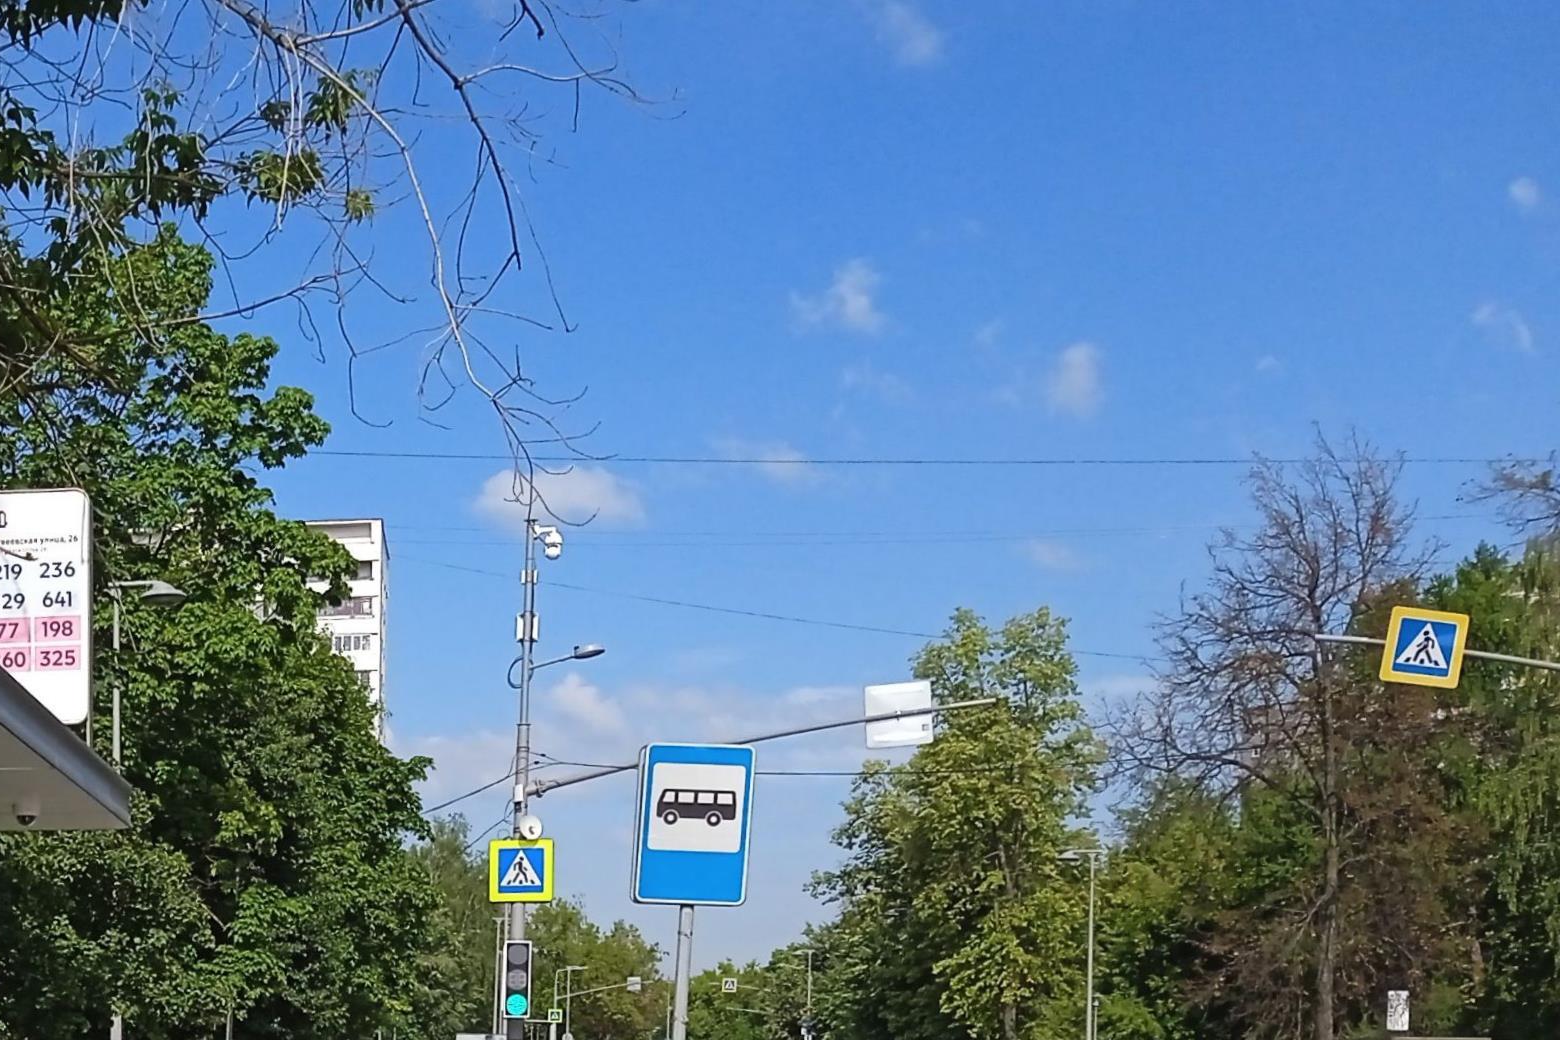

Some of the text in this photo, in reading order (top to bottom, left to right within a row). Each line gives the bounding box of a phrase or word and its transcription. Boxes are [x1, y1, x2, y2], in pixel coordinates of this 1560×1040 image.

[39, 561, 76, 579] 236
[42, 591, 73, 608] 641
[42, 621, 74, 637] 198
[39, 650, 76, 667] 325
